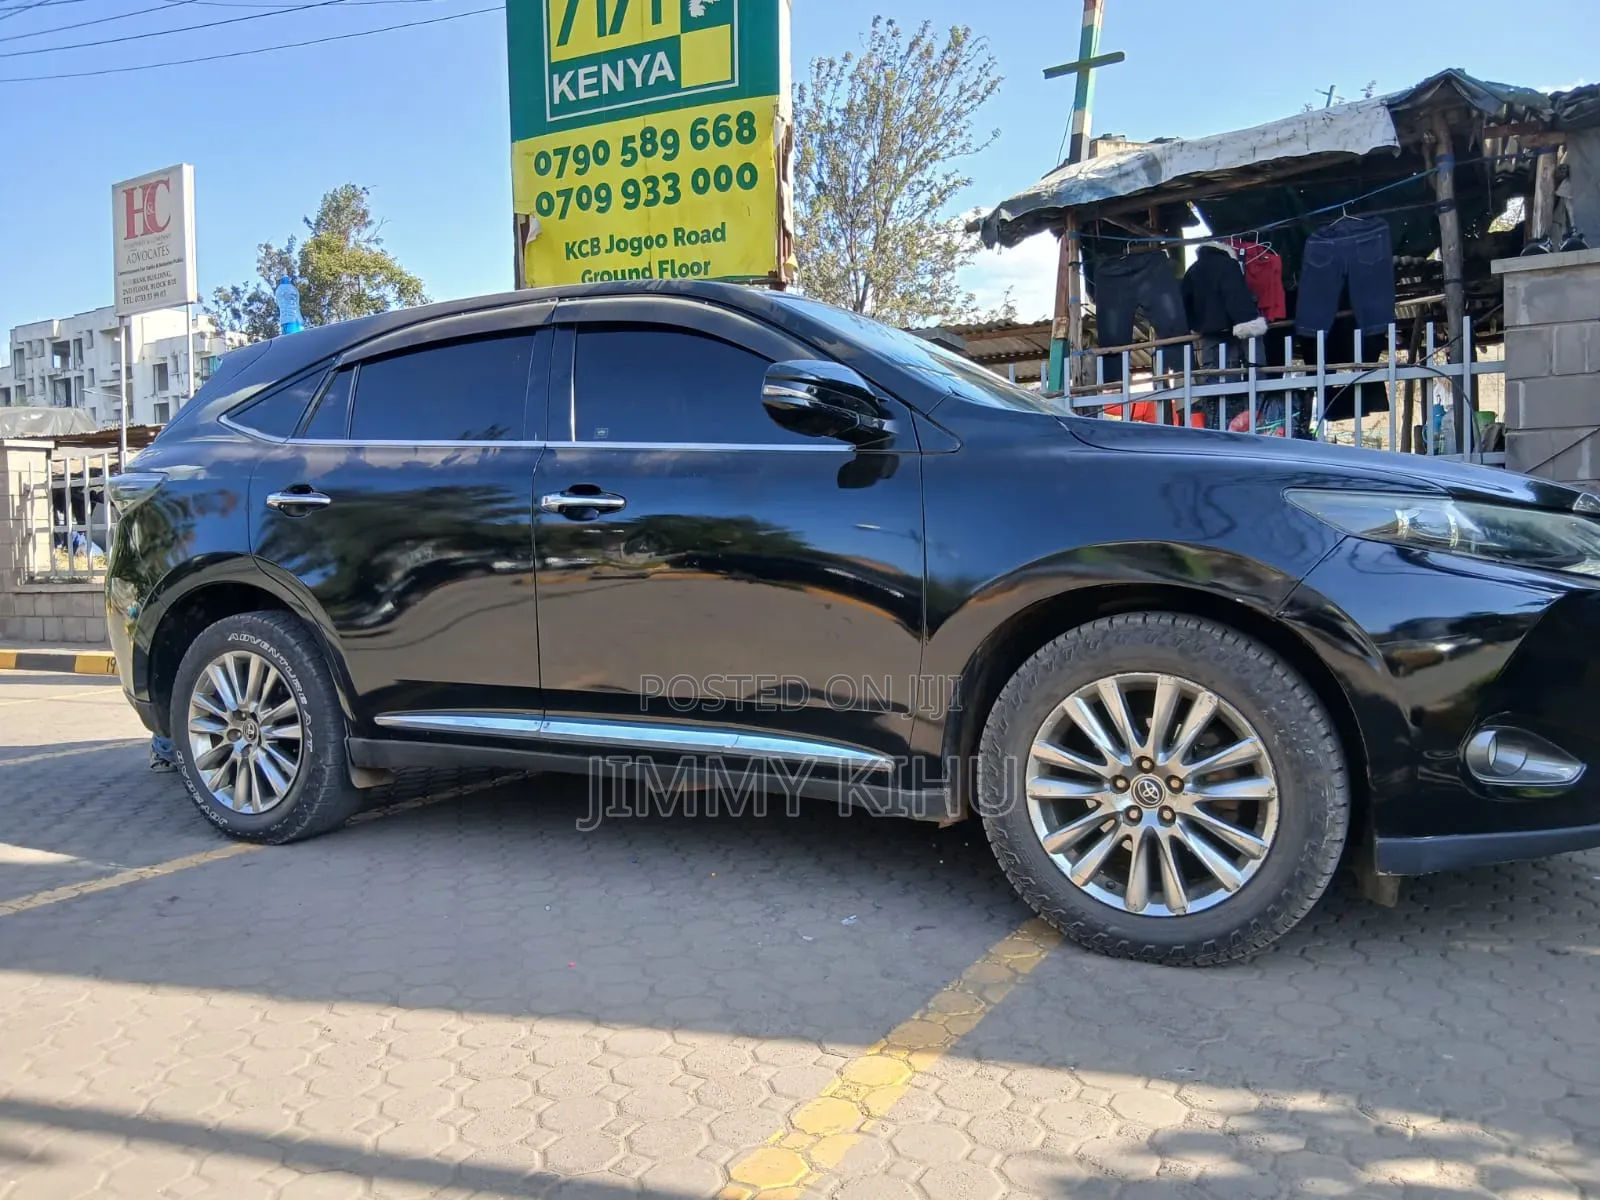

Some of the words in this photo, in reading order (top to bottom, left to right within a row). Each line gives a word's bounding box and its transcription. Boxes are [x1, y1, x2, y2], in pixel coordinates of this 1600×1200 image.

[553, 51, 675, 104] KENYA
[534, 139, 610, 179] 0790
[621, 126, 680, 167] 589
[690, 111, 757, 151] 668
[535, 182, 613, 220] 0709
[621, 172, 681, 210] 933
[691, 163, 758, 195] 000
[126, 244, 170, 265] ADVOCATES
[565, 239, 601, 261] KCB
[605, 232, 667, 256] Jogoo
[674, 222, 727, 247] Road
[581, 262, 653, 283] Ground
[658, 259, 711, 279] Floor
[228, 633, 308, 705] ADVENTURE
[304, 710, 313, 752] A/T
[176, 750, 228, 825] JOYROAD
